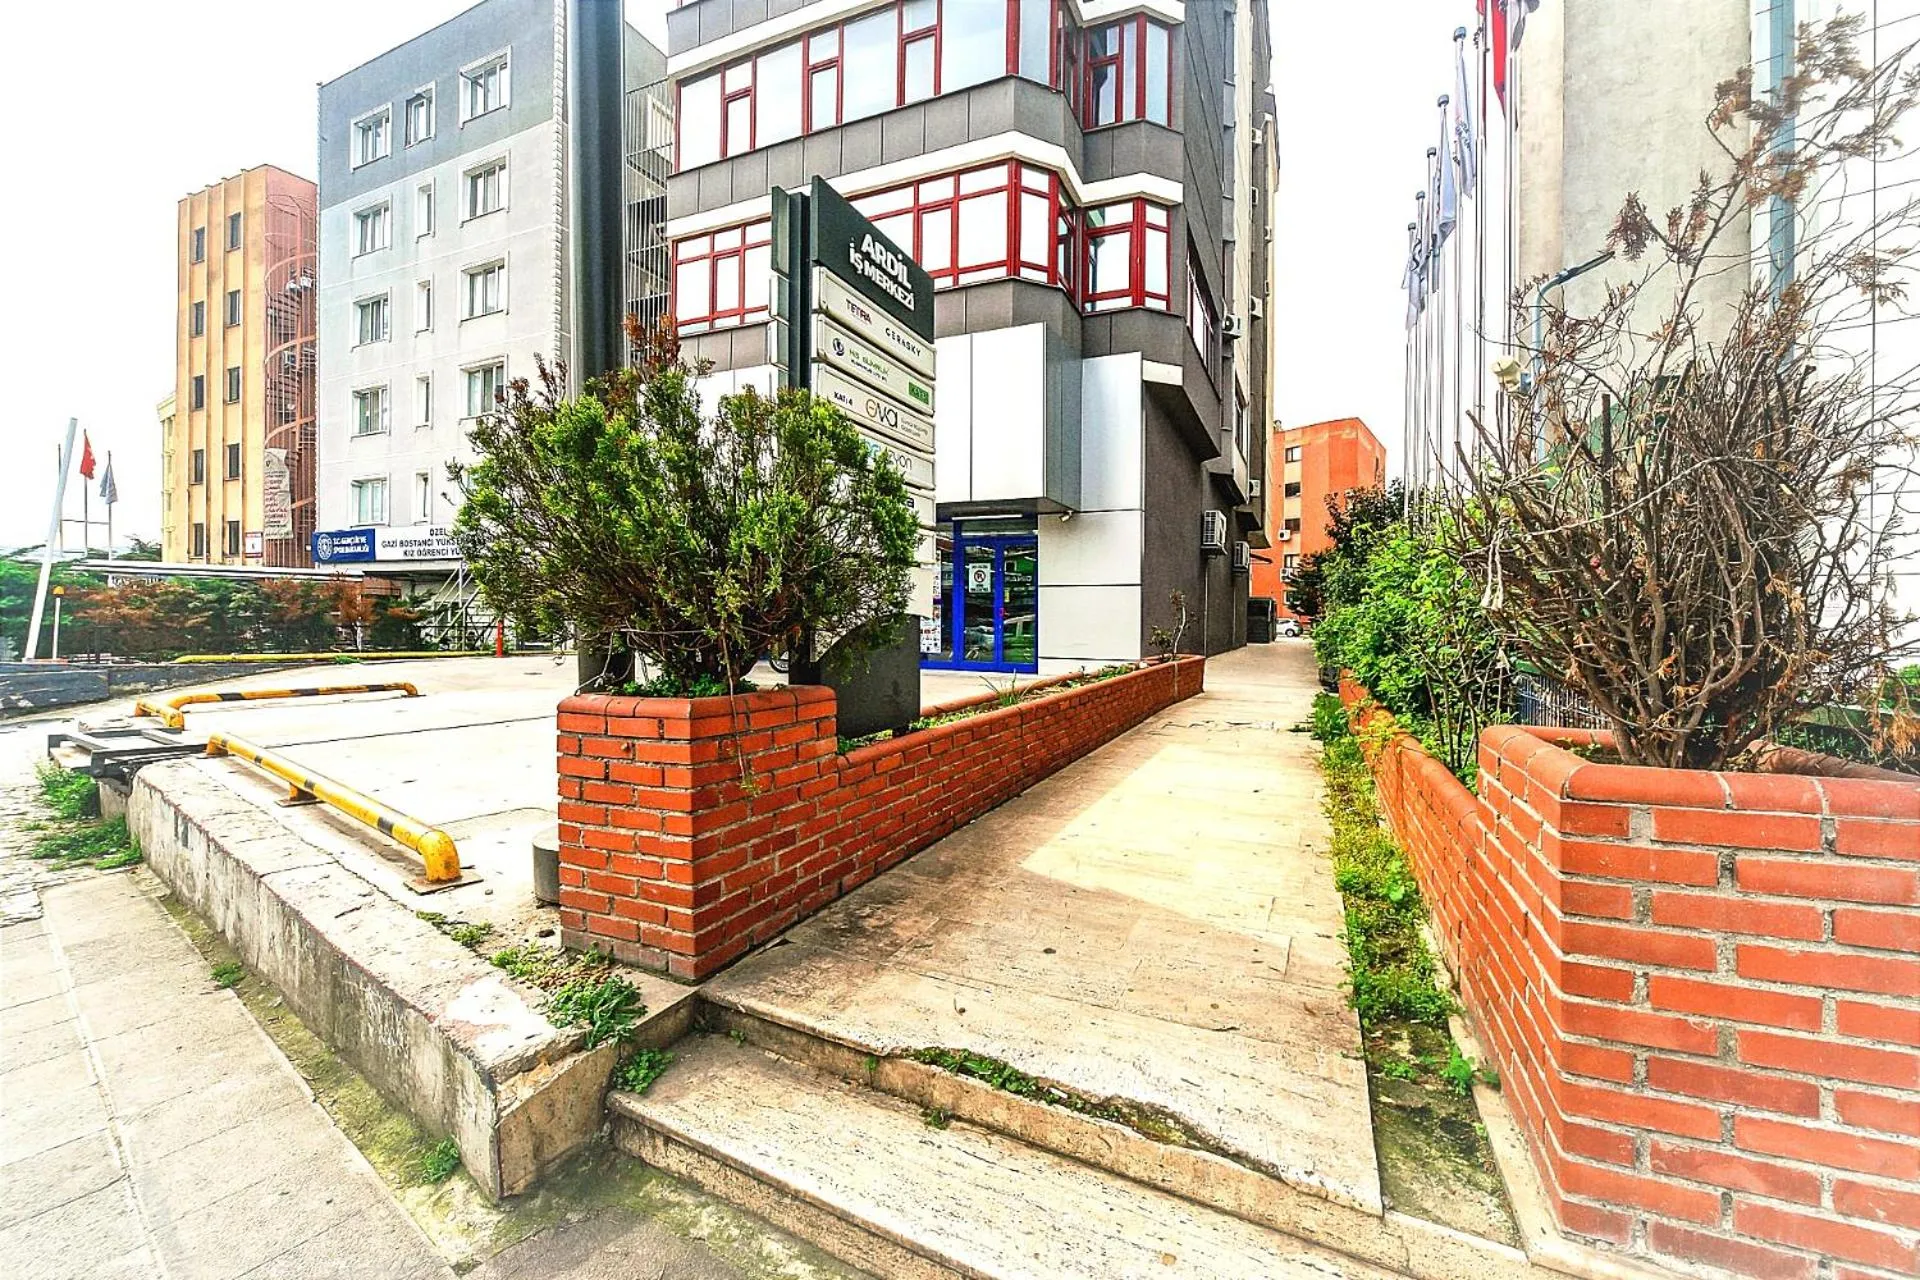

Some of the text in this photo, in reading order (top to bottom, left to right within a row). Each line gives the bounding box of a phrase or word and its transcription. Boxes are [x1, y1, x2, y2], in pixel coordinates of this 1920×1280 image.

[861, 233, 912, 290] ARDİL
[863, 259, 915, 311] MERKEZİ
[846, 298, 873, 325] TETRA
[885, 327, 921, 357] CERASKY
